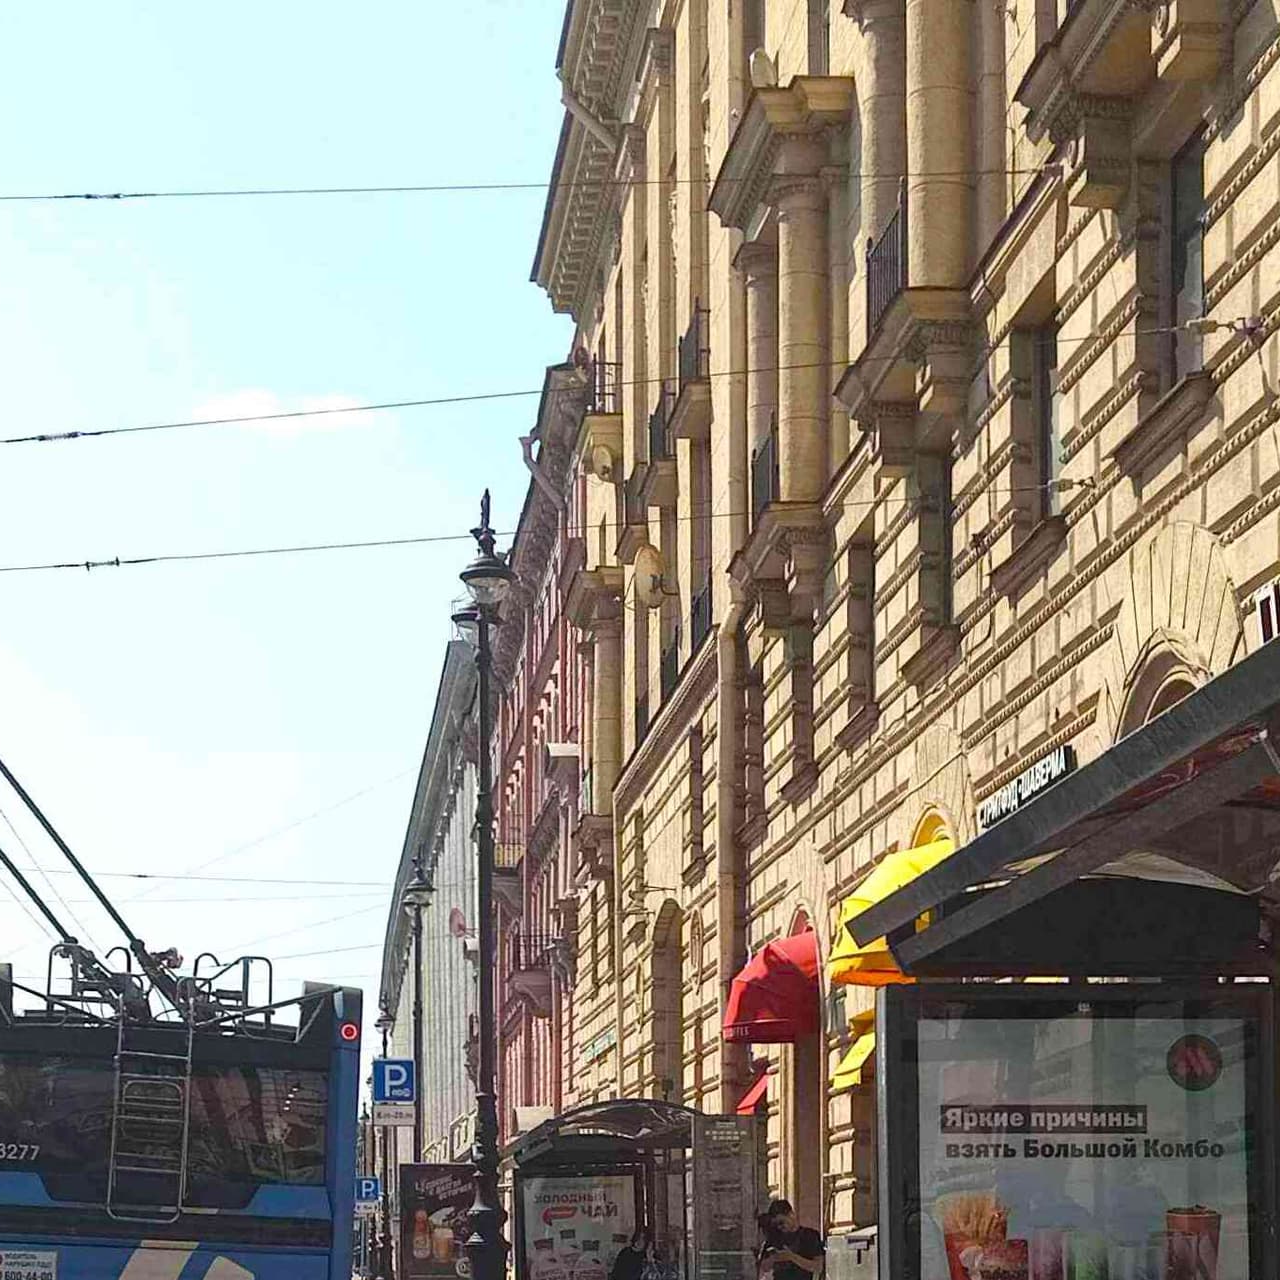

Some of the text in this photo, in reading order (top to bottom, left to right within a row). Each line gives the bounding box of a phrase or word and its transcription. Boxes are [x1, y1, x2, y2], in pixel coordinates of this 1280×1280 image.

[1020, 744, 1066, 801] ШАВЕРМА
[384, 1064, 408, 1098] P
[945, 1108, 1144, 1131] Яркие причины
[945, 1137, 1225, 1159] взять Большой Комбо
[361, 1179, 375, 1198] P
[581, 1201, 619, 1218] ЧАЙ
